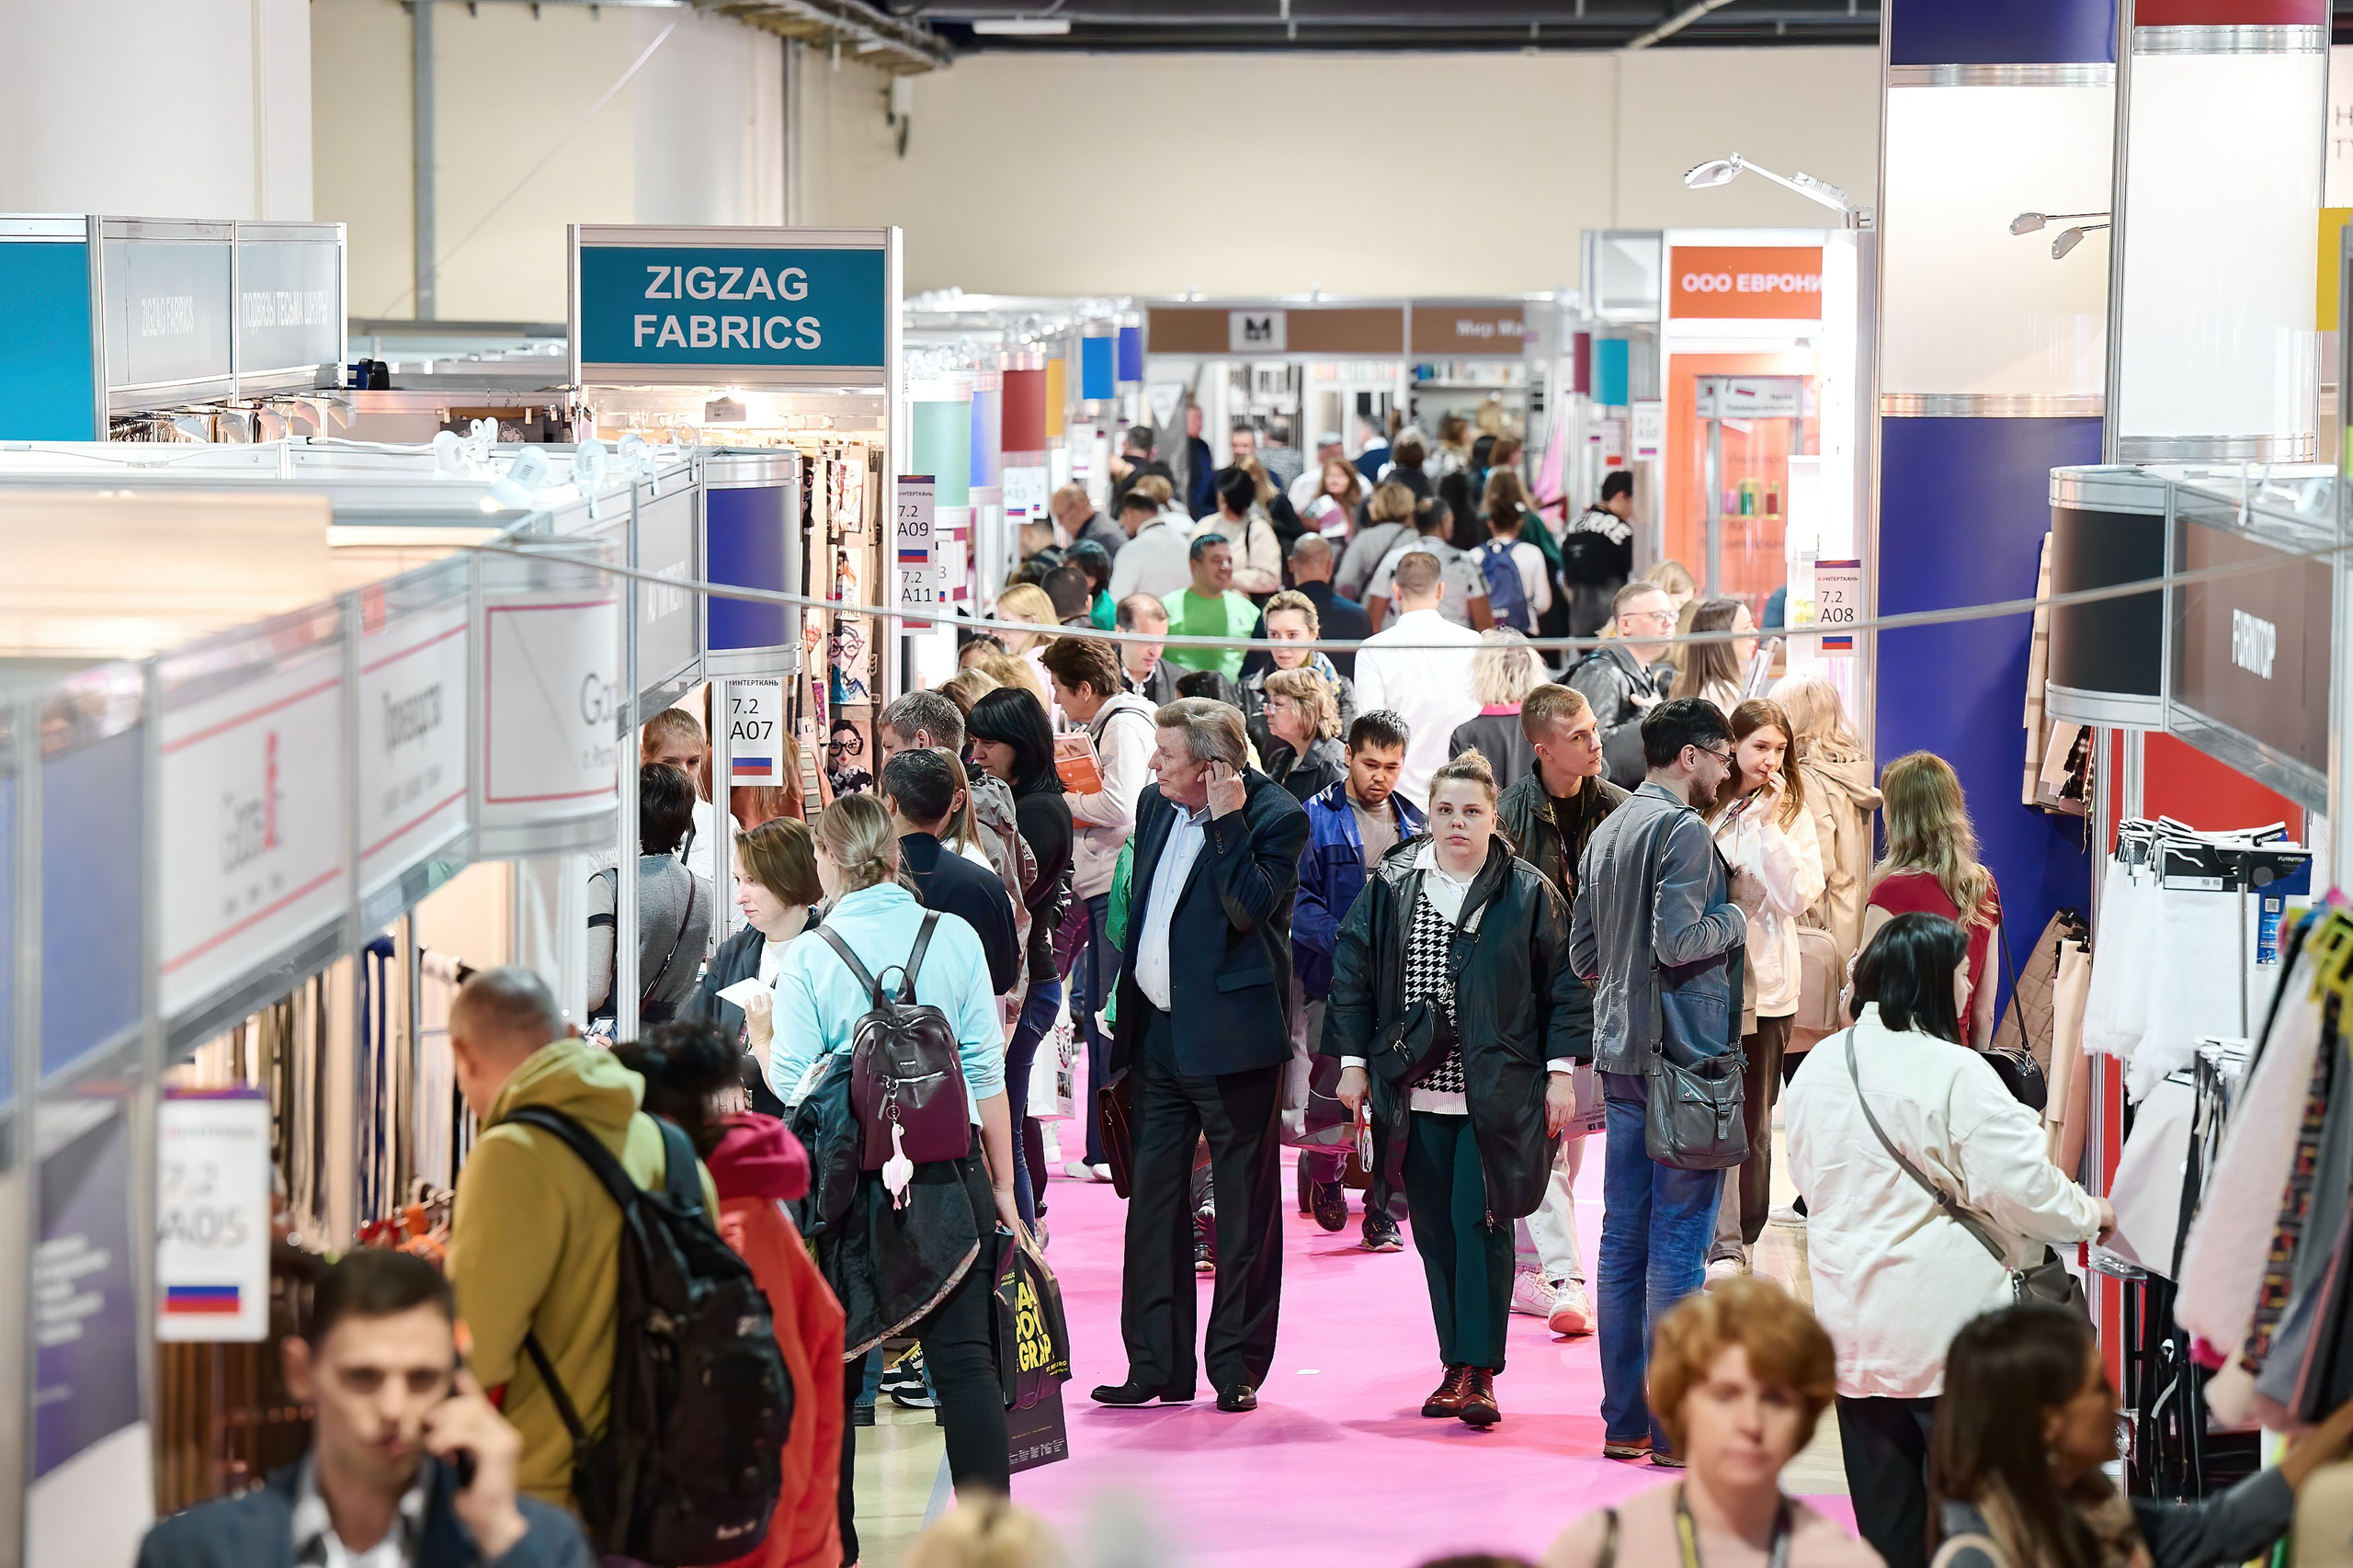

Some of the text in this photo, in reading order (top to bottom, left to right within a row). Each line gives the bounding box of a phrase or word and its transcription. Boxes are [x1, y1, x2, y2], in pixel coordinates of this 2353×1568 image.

[644, 266, 808, 301] ZIGZAG
[1682, 273, 1733, 293] ООО
[142, 295, 194, 337] ZIGZAG FABRICS
[243, 292, 276, 335] ПОДВЯЗЫ
[277, 291, 303, 326] ТЕСЬМА
[634, 314, 822, 350] FABRICS
[898, 505, 918, 517] 7.2
[897, 521, 929, 537] A09
[903, 571, 922, 584] 7.2
[902, 587, 932, 602] A11
[1822, 590, 1843, 603] 7.2
[1820, 607, 1854, 623] A08
[731, 698, 759, 714] 7.2
[730, 721, 773, 741] A07
